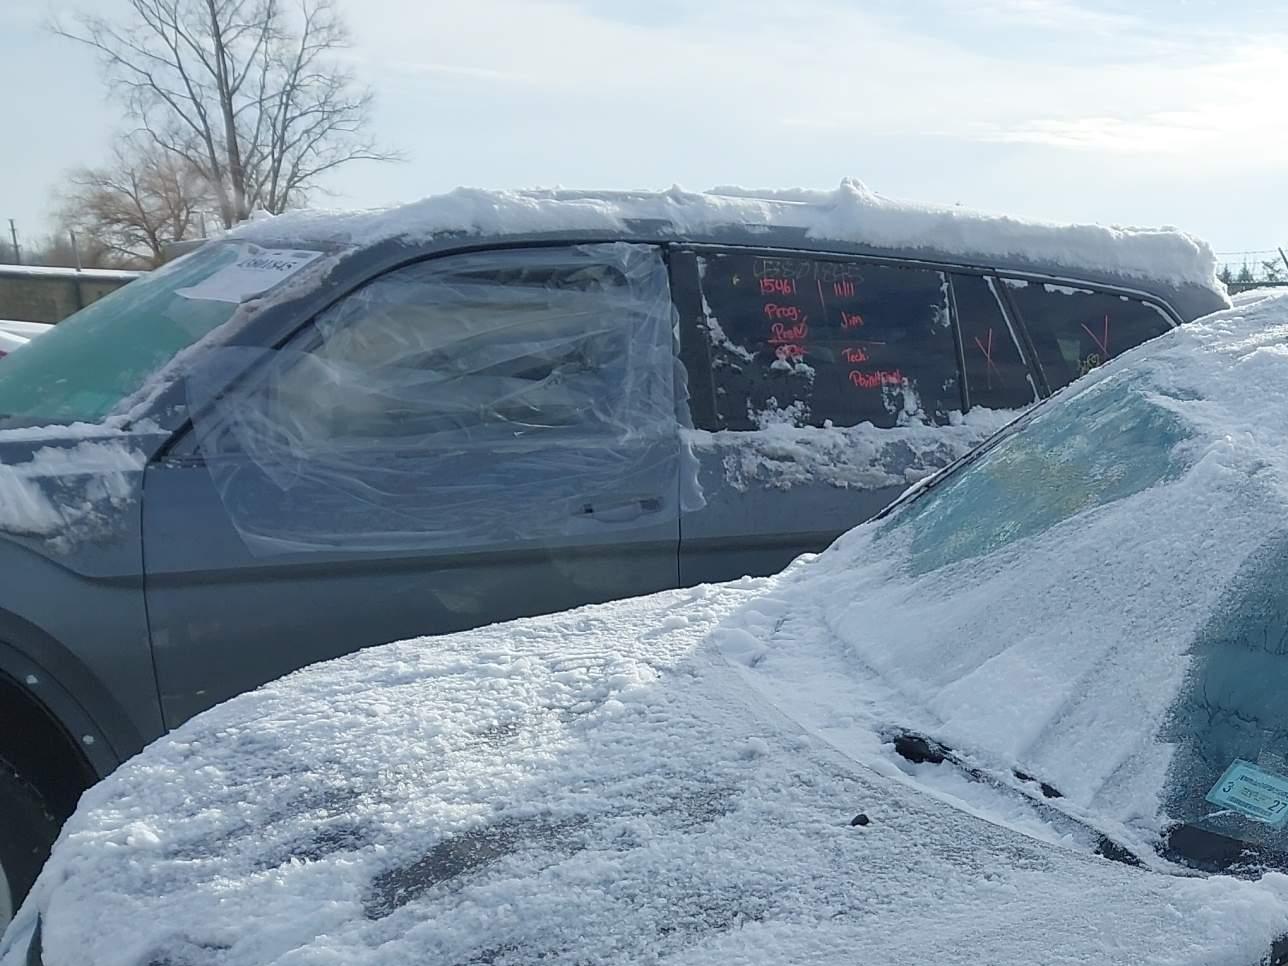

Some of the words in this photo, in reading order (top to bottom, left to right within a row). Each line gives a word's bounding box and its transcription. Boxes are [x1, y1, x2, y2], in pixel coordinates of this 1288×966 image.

[841, 311, 864, 328] Jim
[1222, 781, 1235, 793] 3
[1267, 799, 1288, 814] 27
